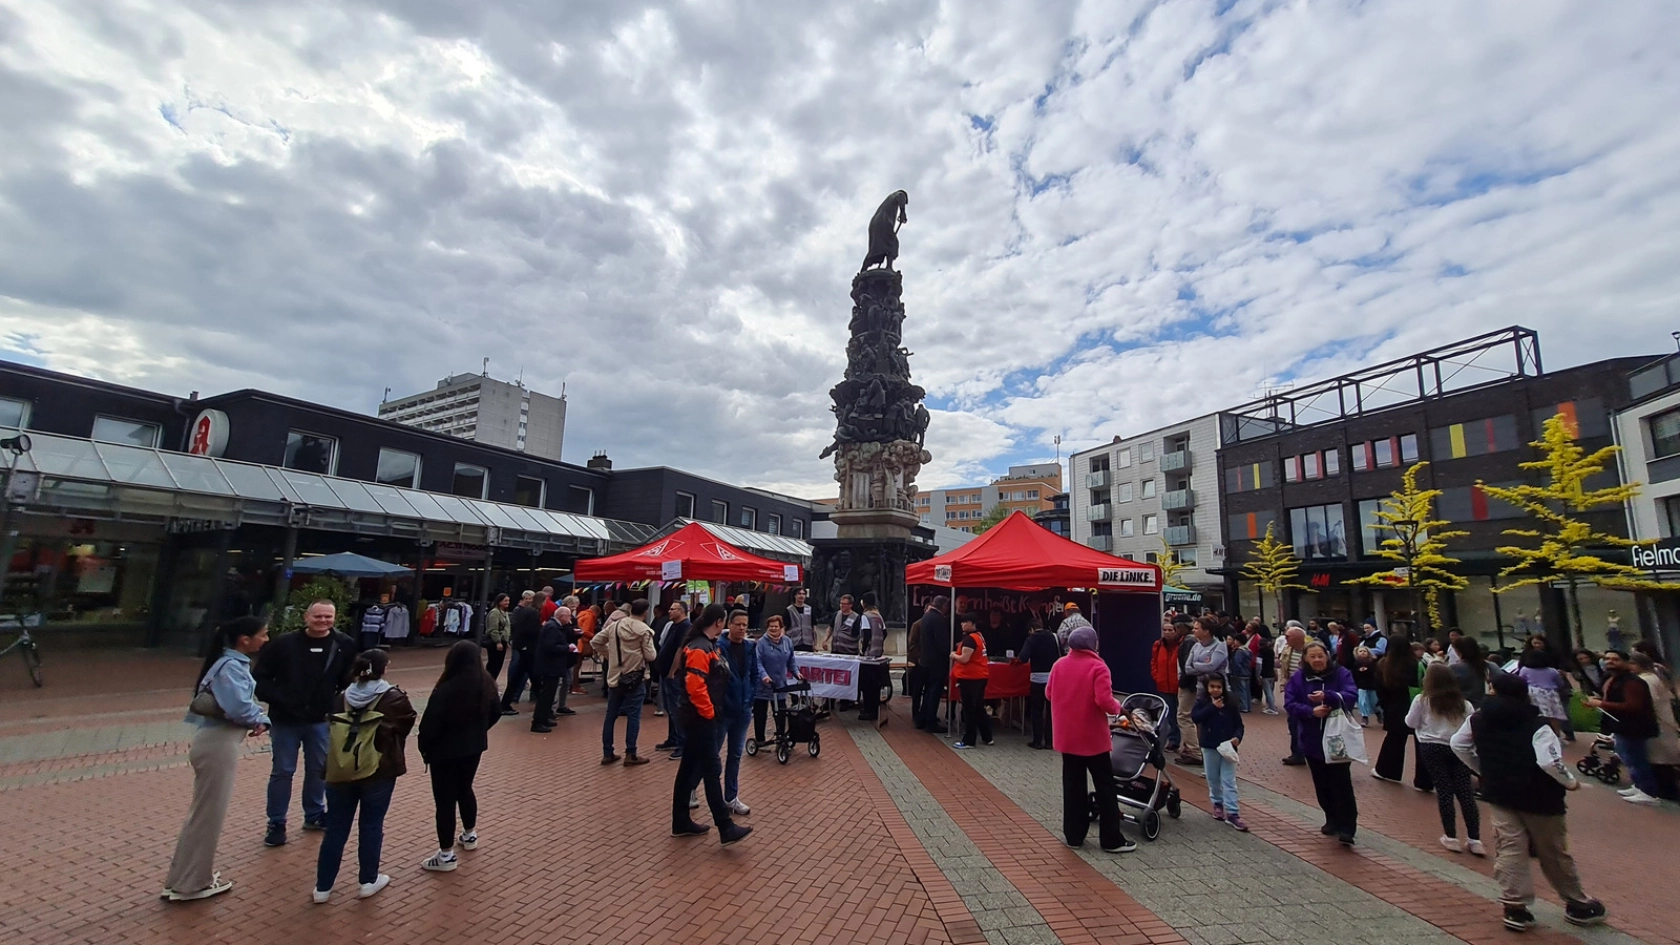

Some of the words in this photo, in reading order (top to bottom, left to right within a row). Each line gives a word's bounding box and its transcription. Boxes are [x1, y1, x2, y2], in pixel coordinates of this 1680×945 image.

[1102, 571, 1119, 582] DIE
[1311, 573, 1330, 586] H&M
[1165, 592, 1202, 602] gruene.de
